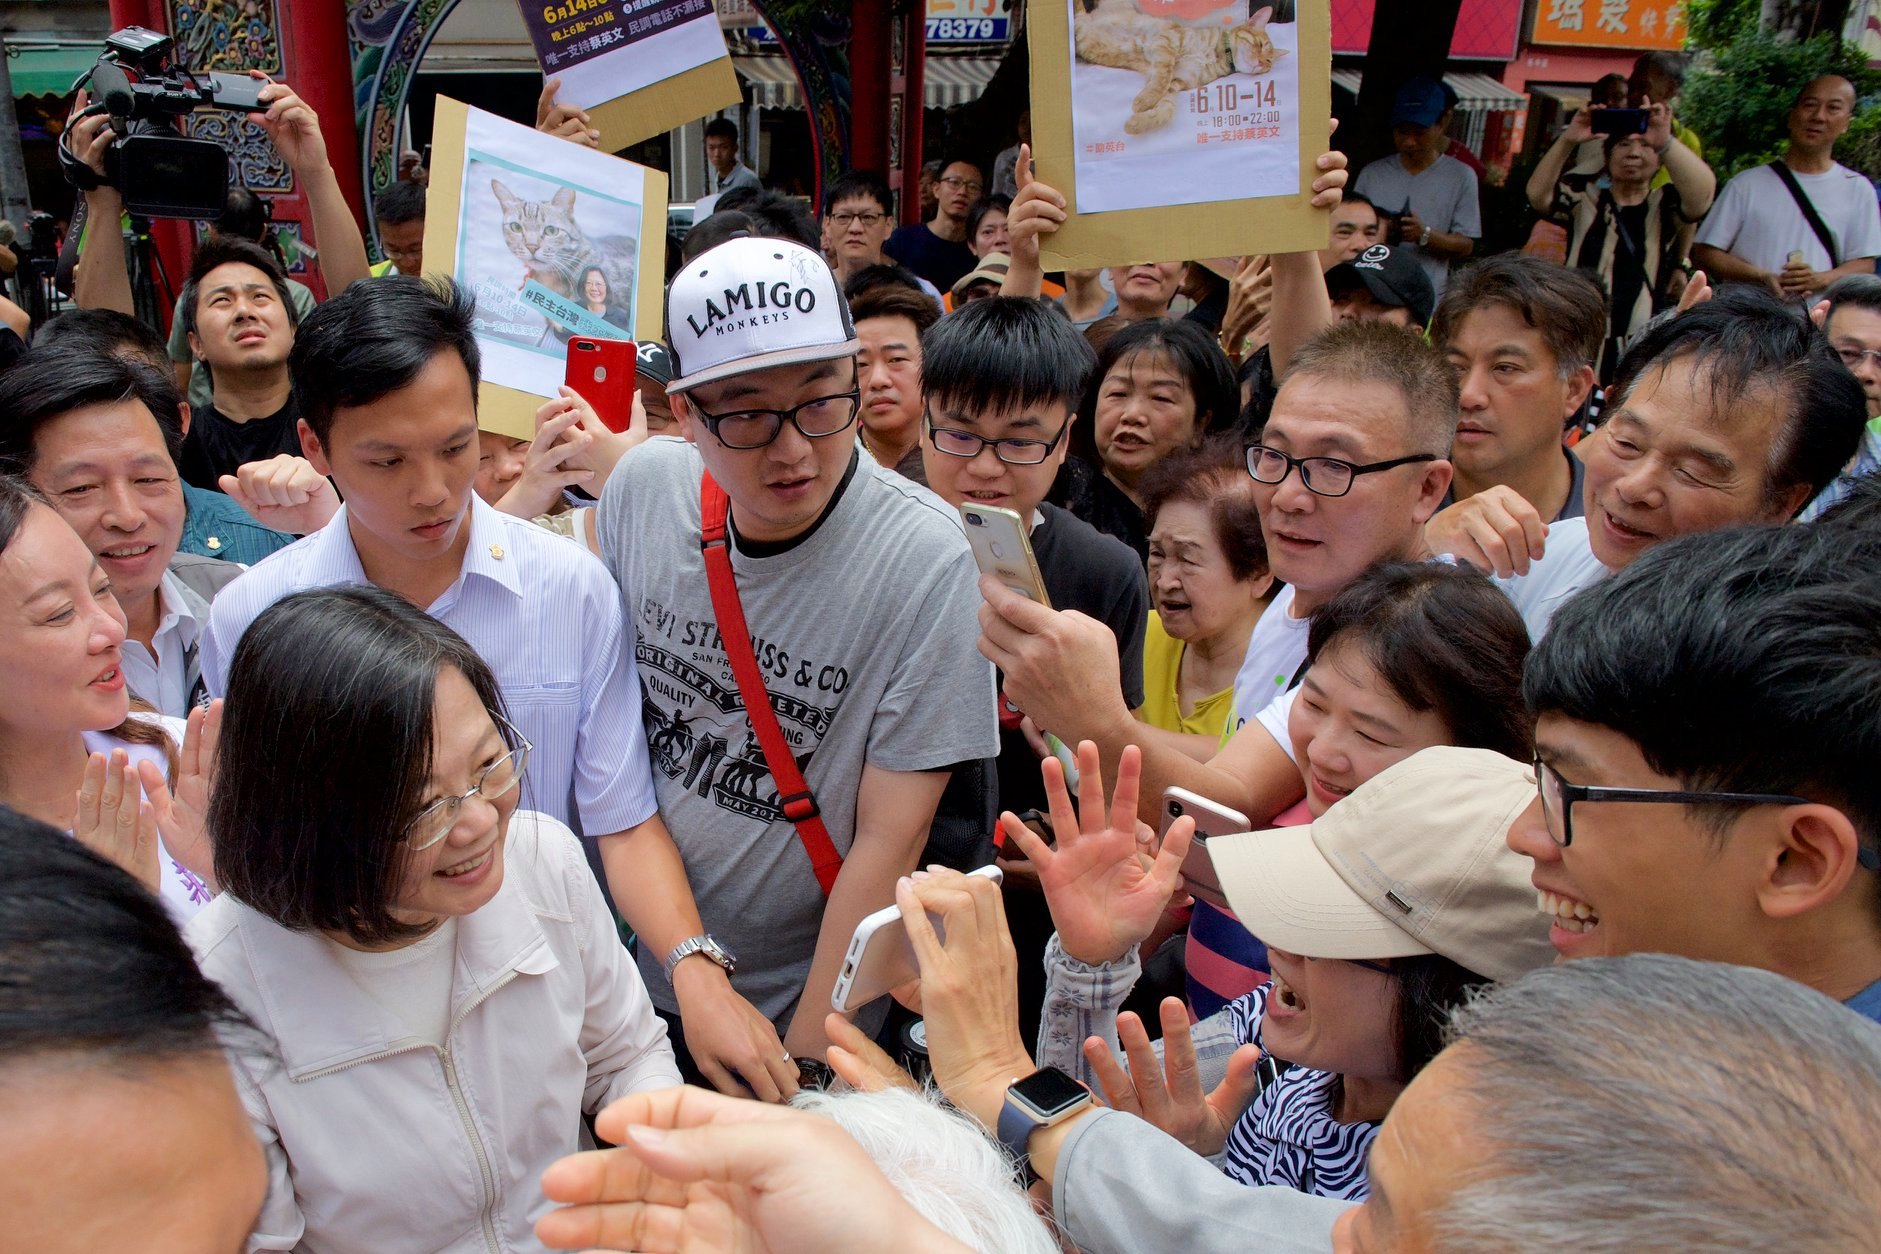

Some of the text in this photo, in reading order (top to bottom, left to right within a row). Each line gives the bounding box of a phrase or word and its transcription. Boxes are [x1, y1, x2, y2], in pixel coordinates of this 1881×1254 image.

[926, 19, 994, 38] 78379
[545, 27, 625, 65] 唯一支持蔡英文
[69, 201, 87, 243] SONY
[686, 281, 816, 339] LAMIGO
[715, 311, 789, 336] MONKEYS
[692, 652, 713, 664] SAN
[636, 646, 724, 705] ORIGINAL
[794, 660, 812, 688] &
[650, 675, 696, 709] QUALITY
[722, 797, 750, 811] MAY
